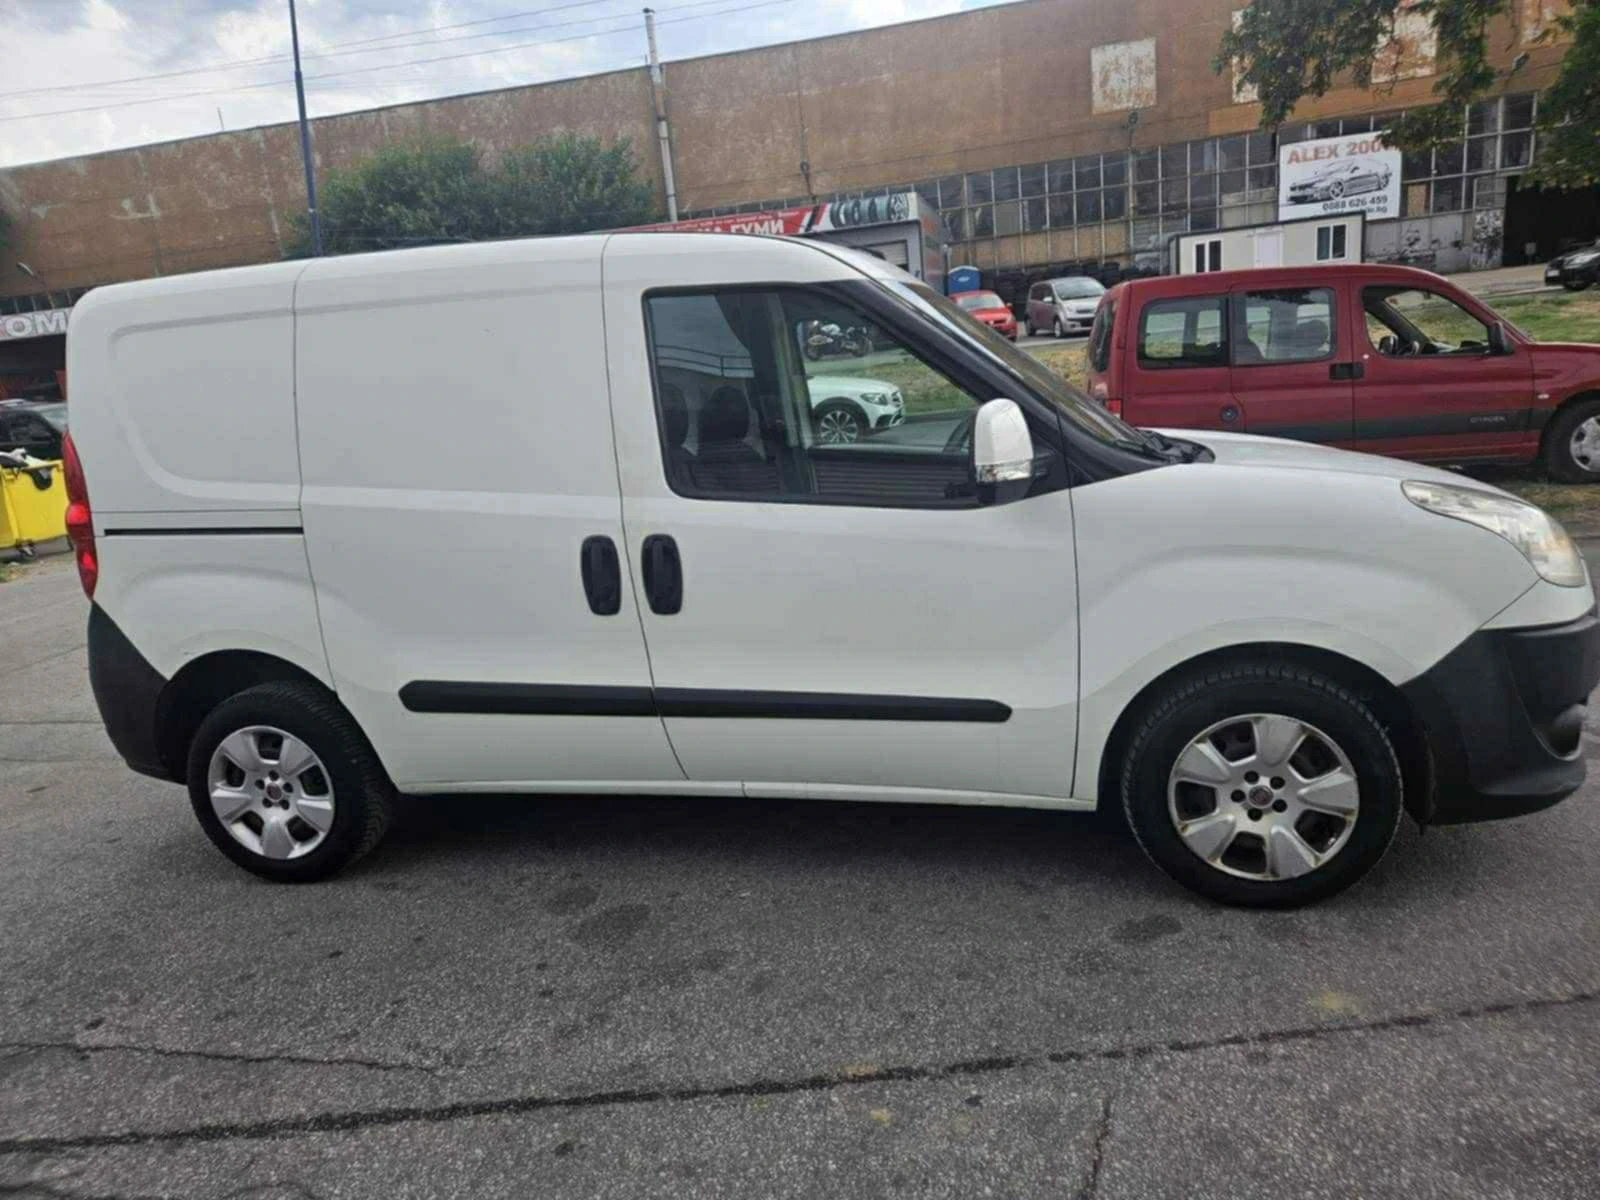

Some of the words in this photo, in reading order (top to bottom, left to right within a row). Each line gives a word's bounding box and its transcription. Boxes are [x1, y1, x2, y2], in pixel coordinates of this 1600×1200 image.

[1287, 143, 1339, 164] ALEX
[1346, 139, 1387, 156] 200
[1348, 197, 1368, 208] 626
